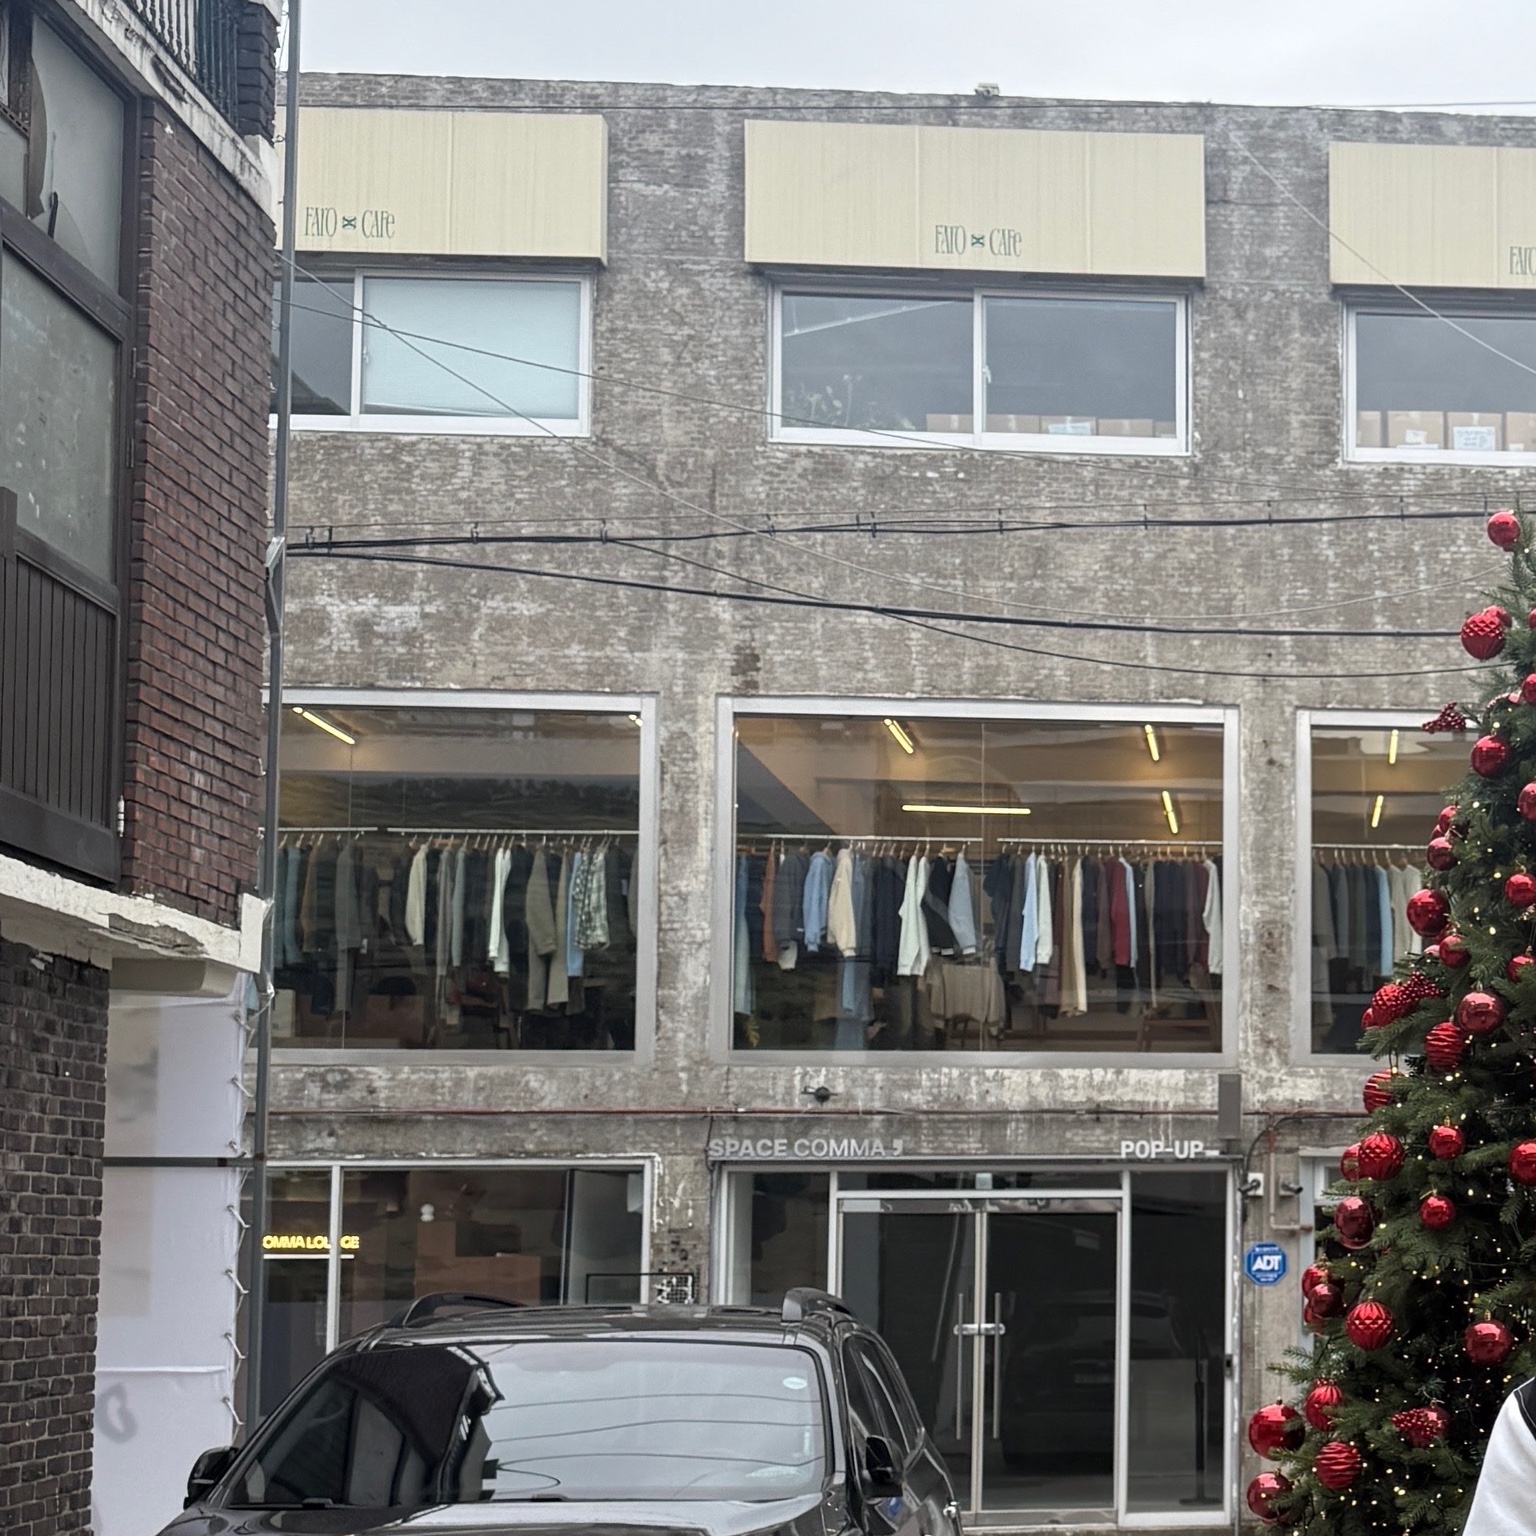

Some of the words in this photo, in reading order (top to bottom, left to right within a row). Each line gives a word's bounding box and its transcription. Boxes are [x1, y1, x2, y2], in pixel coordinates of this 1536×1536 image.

[708, 1138, 788, 1158] SPACE
[793, 1138, 886, 1158] COMMA
[1120, 1140, 1204, 1160] POP-UP
[262, 1235, 306, 1250] OMMA
[1251, 1254, 1283, 1271] ADT
